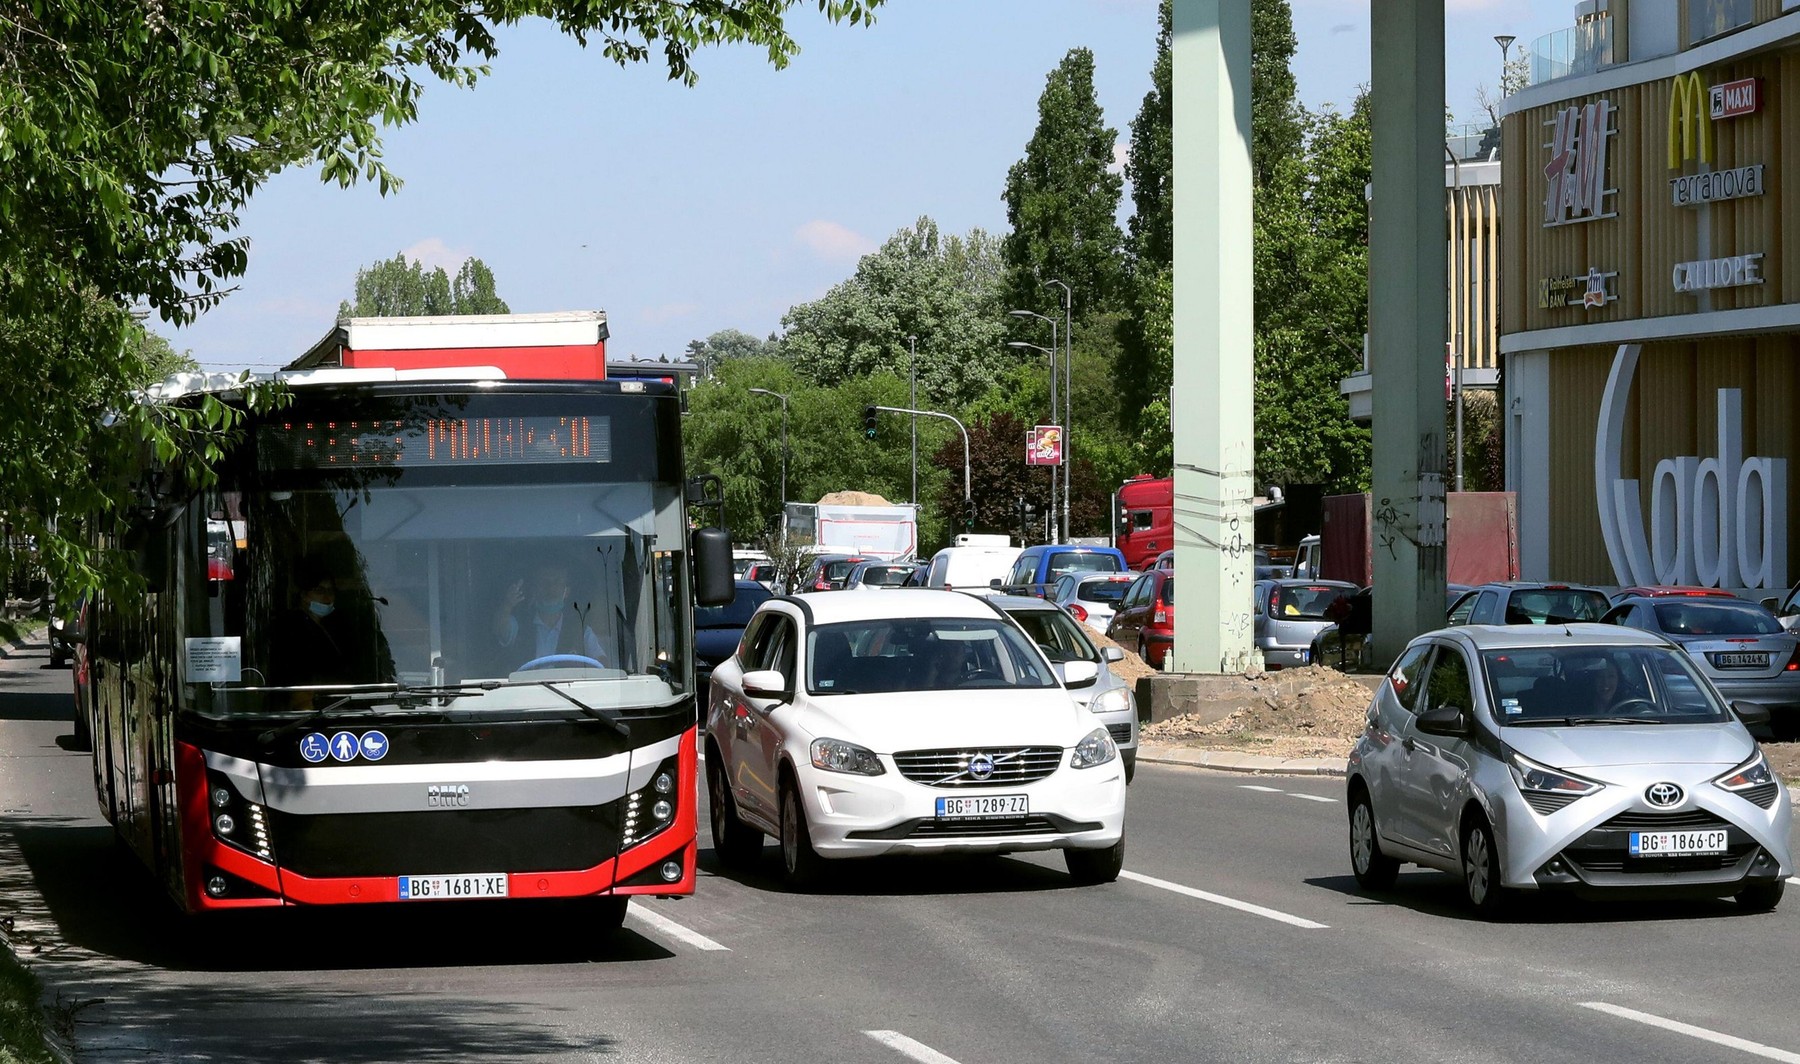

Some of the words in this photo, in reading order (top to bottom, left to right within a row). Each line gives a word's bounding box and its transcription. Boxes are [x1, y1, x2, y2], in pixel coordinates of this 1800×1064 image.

[1725, 84, 1753, 110] MAXI
[1544, 100, 1609, 223] H&M
[1588, 270, 1601, 292] dm
[1672, 254, 1759, 291] CALLIOPE
[428, 785, 469, 807] BMC
[947, 800, 963, 814] BG
[1642, 835, 1658, 850] BG
[411, 880, 430, 896] BG
